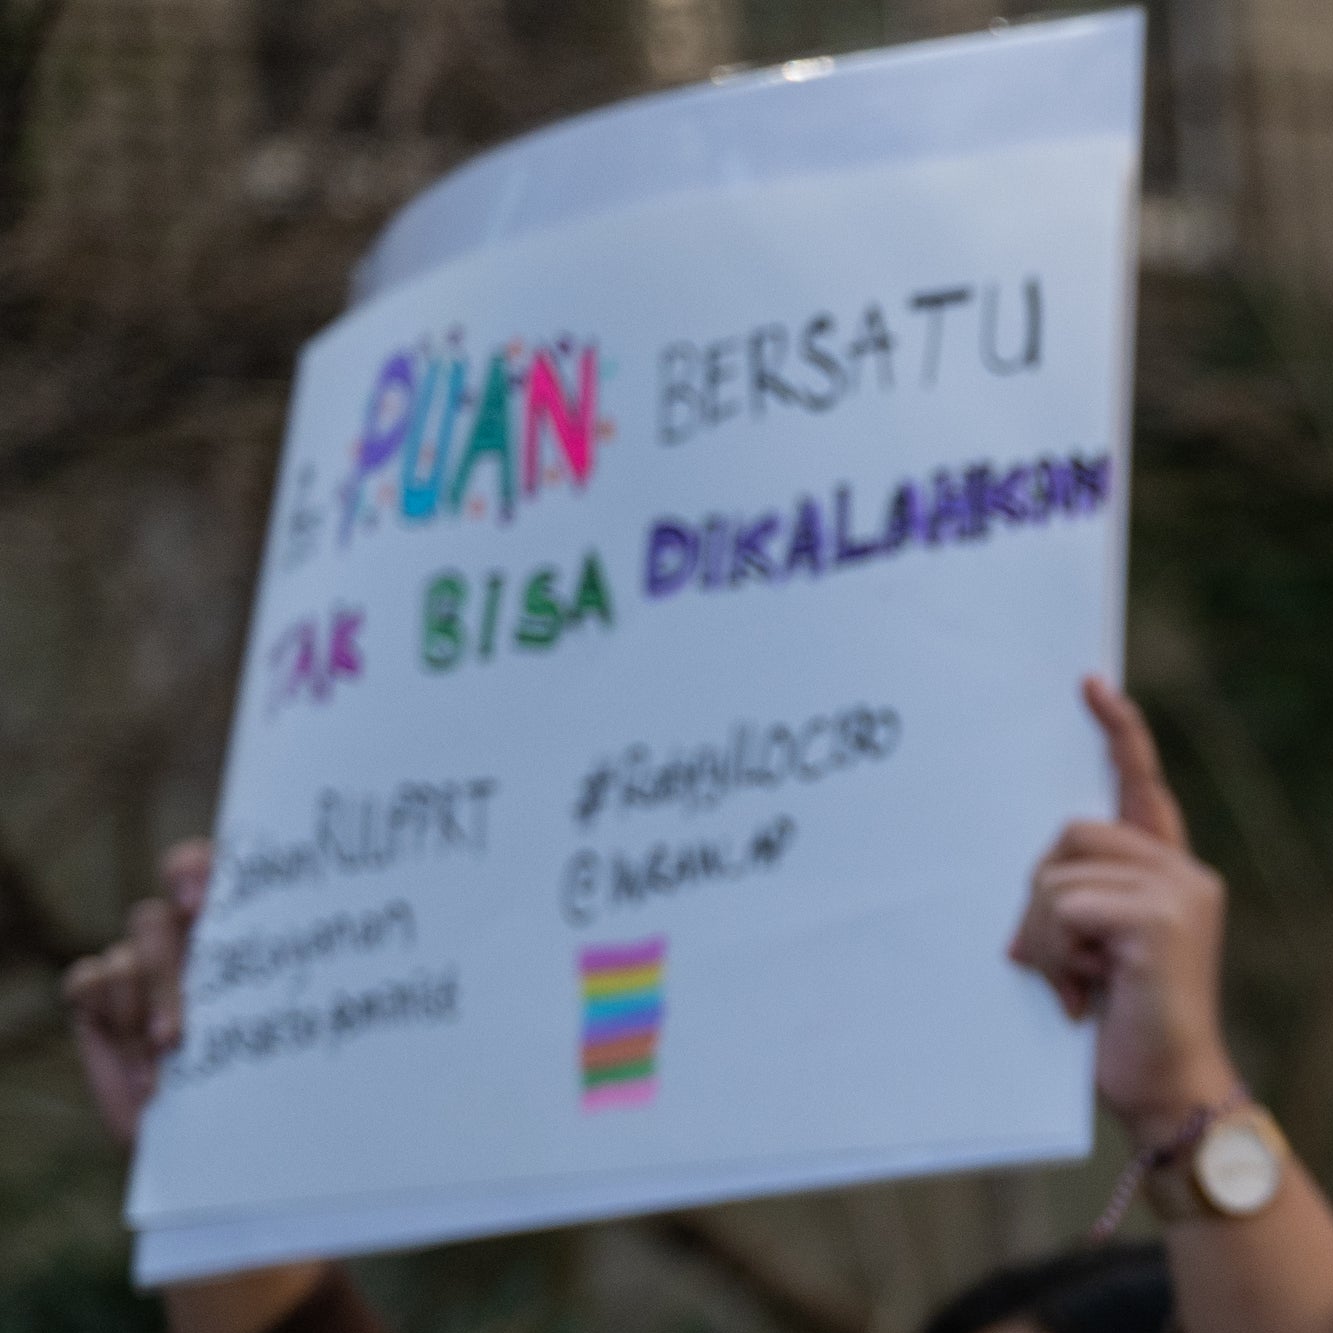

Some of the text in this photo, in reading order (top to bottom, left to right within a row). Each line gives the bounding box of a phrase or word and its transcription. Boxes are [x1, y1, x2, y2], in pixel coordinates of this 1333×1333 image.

[656, 276, 1044, 448] BERSATU
[420, 548, 616, 678] BISA
[643, 451, 1114, 601] DIKALAHKAN
